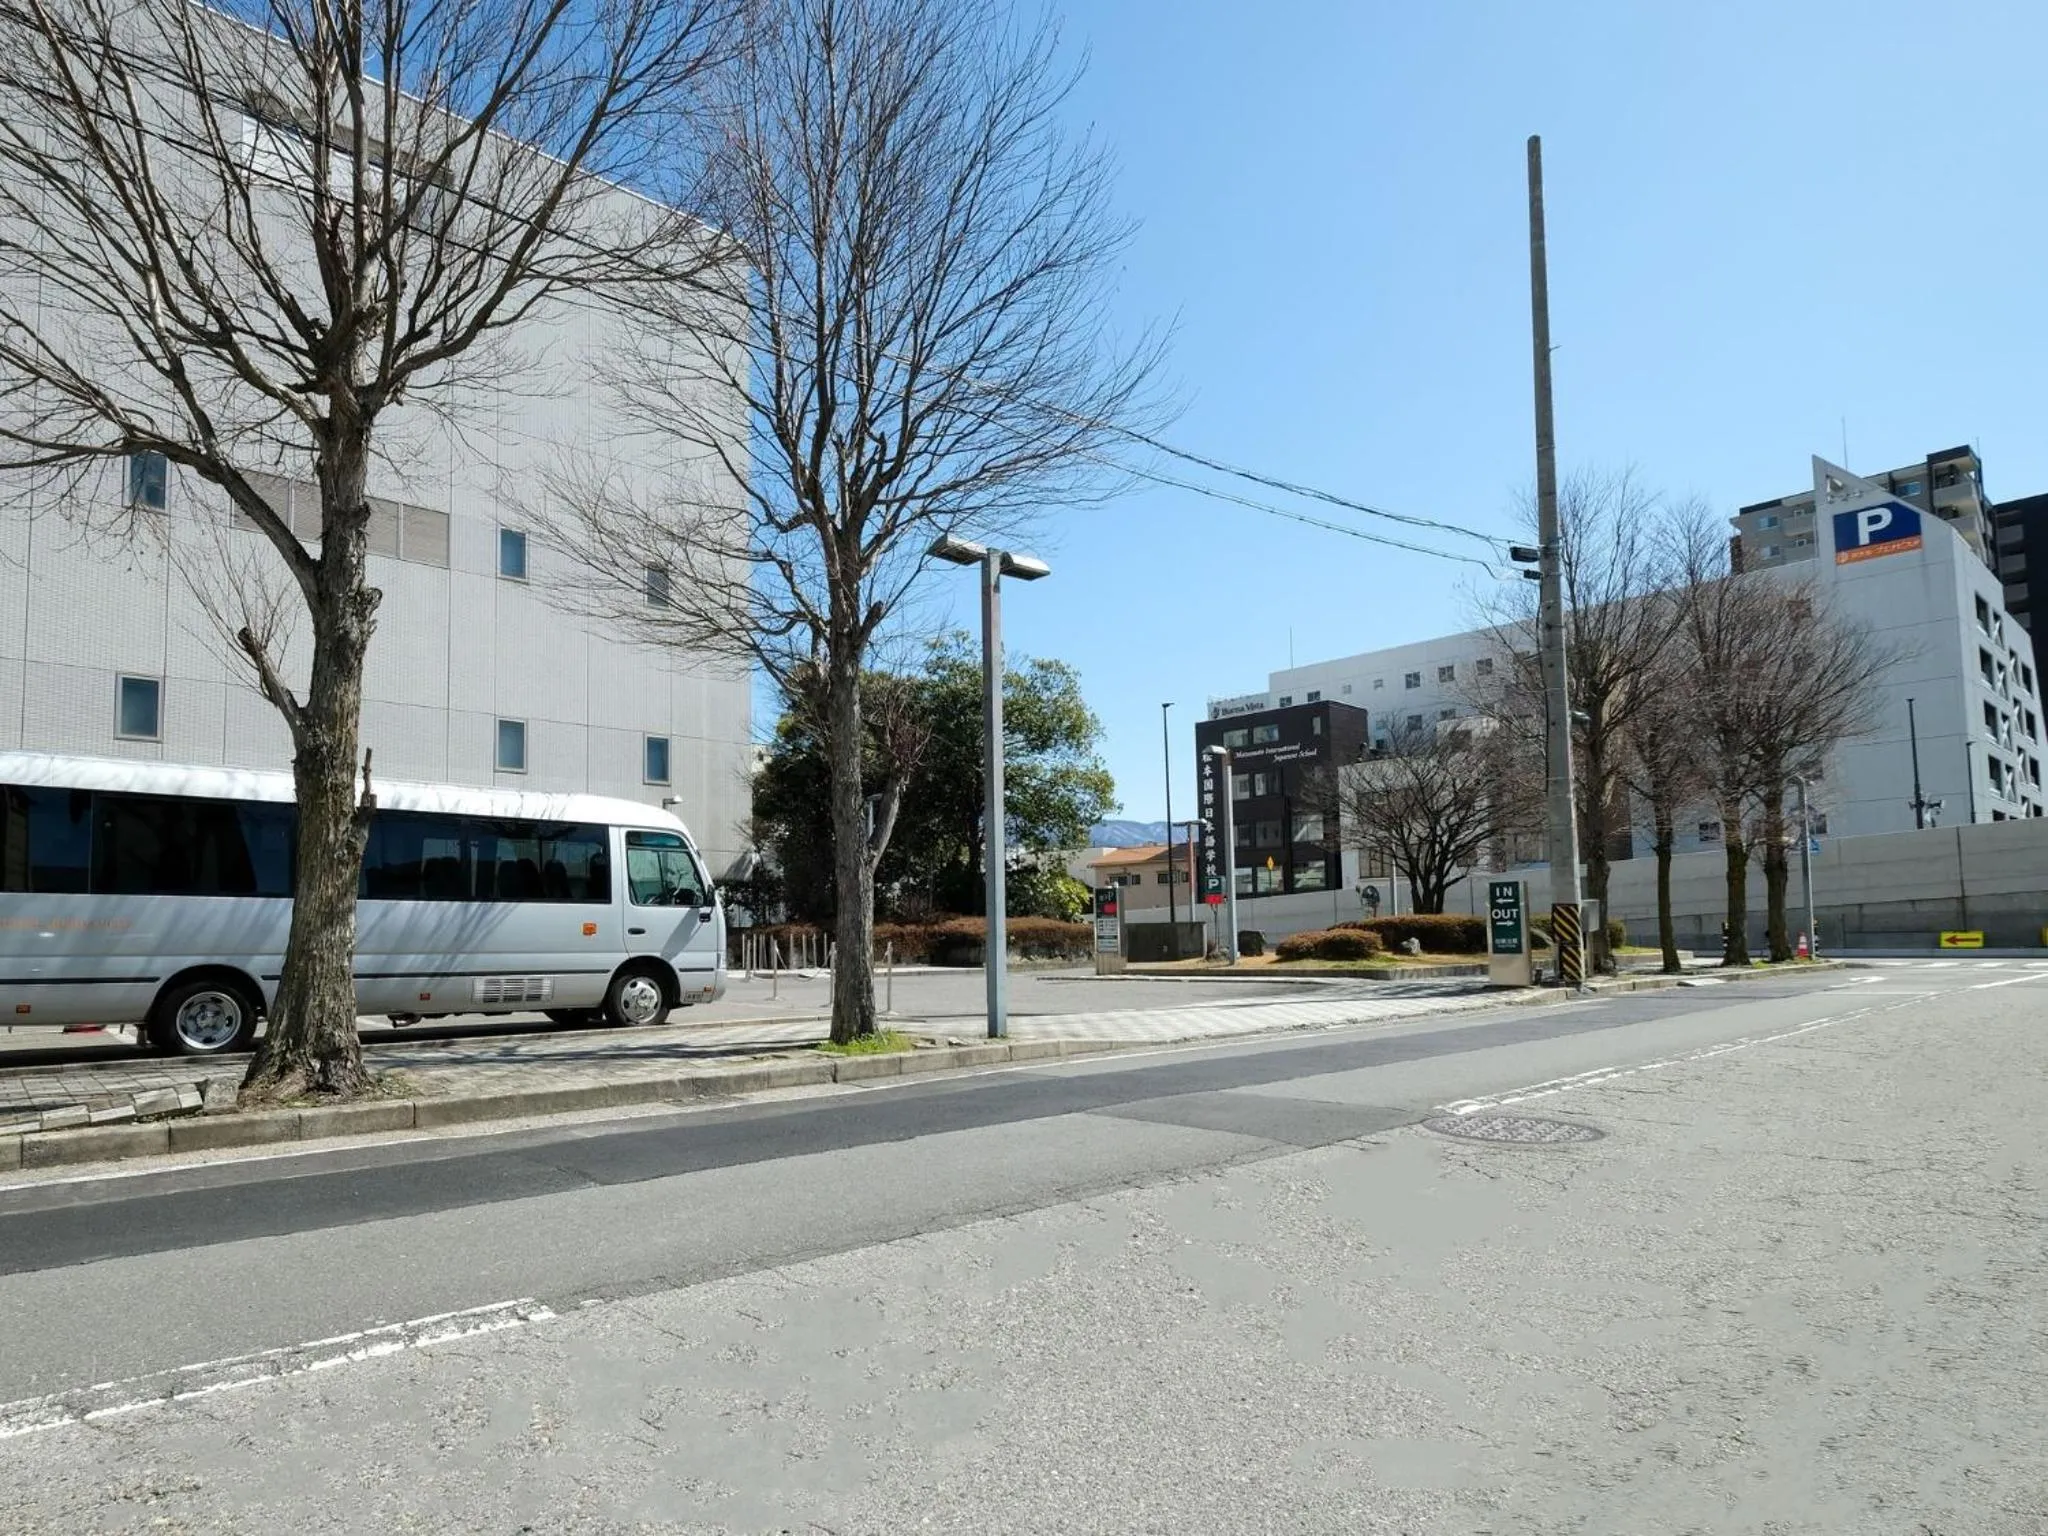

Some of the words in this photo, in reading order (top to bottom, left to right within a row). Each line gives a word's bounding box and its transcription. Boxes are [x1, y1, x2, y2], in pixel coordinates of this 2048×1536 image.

[1857, 507, 1893, 545] P
[1299, 748, 1317, 758] School
[1202, 754, 1216, 876] 松本国際日本語学校
[1208, 878, 1220, 889] P
[1496, 887, 1512, 897] IN
[1492, 909, 1518, 919] OUT
